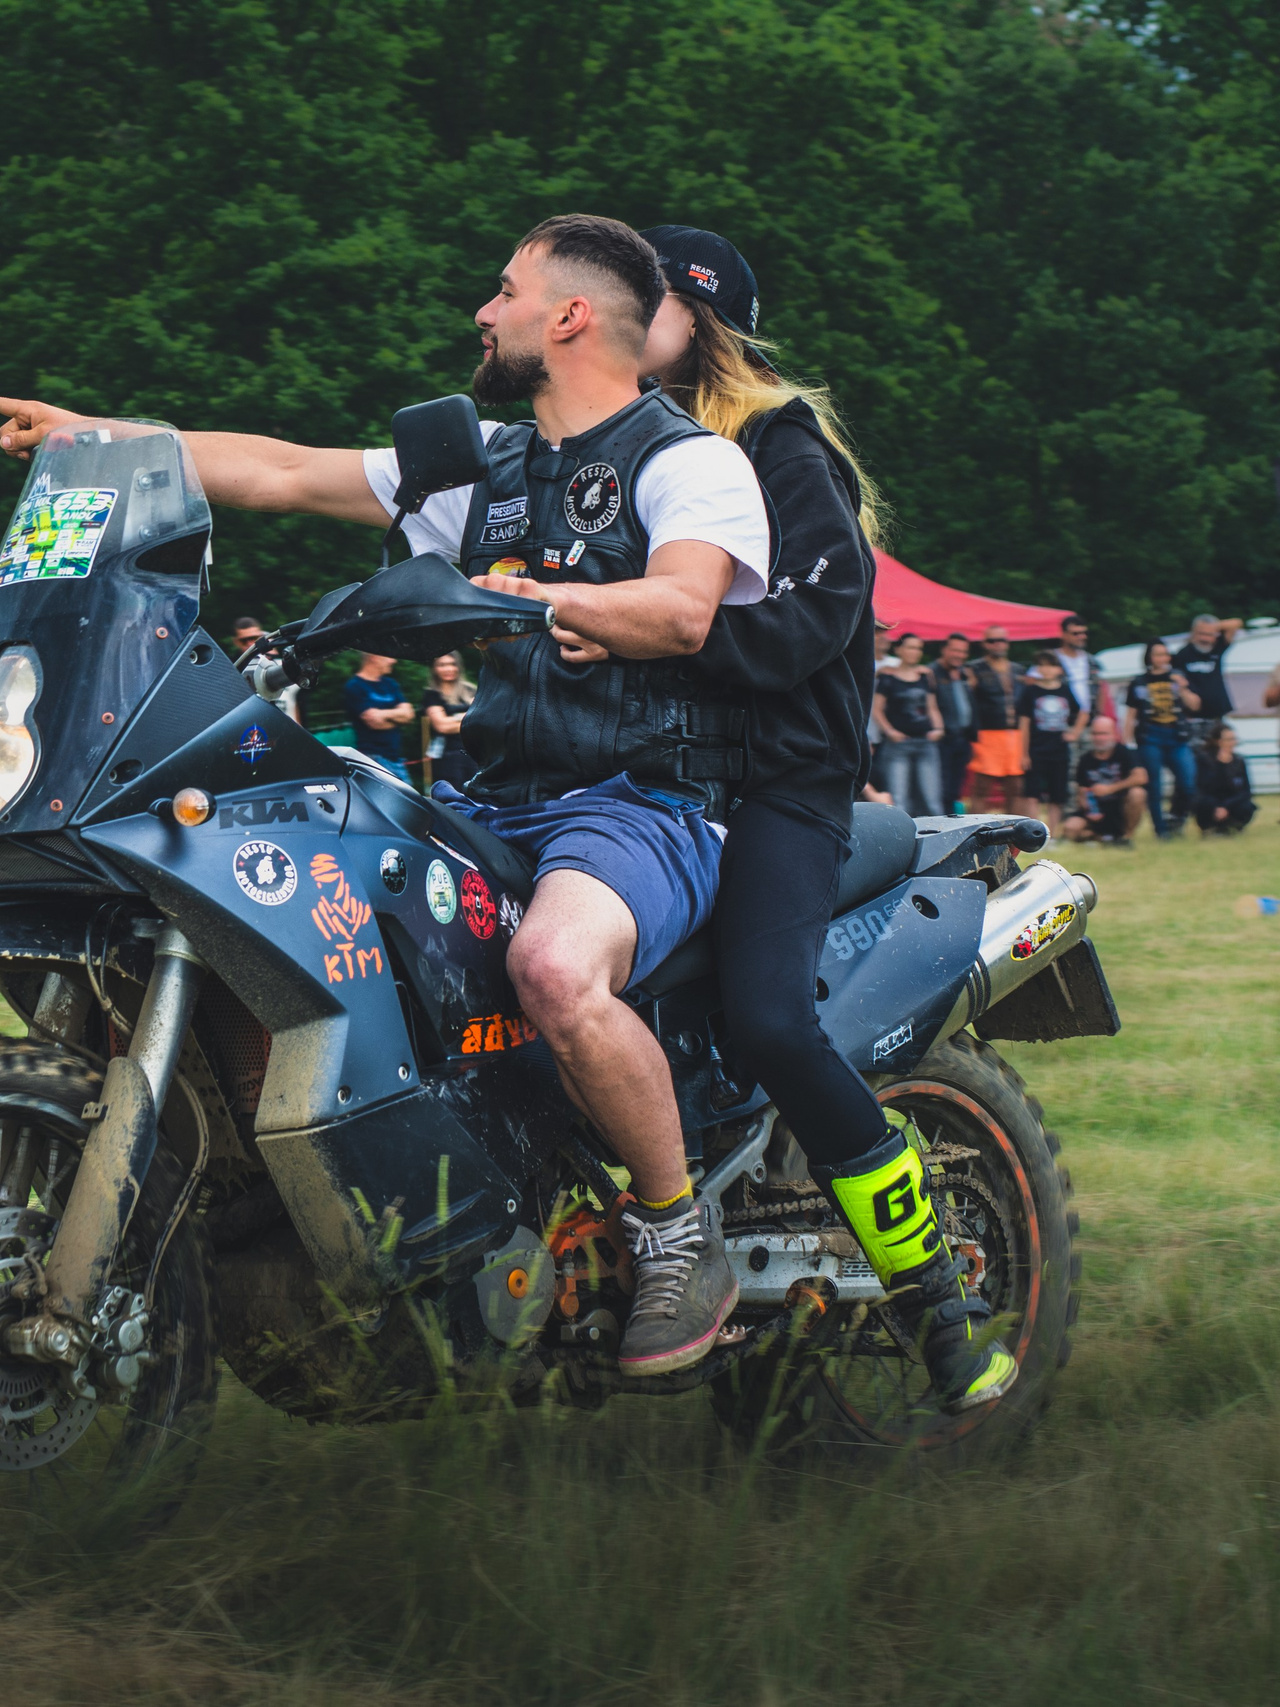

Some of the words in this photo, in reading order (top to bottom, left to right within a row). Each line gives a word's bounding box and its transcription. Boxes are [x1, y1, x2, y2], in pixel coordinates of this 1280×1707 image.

[690, 263, 717, 278] READY
[709, 276, 719, 287] TO
[696, 278, 718, 294] RACE
[53, 492, 114, 512] 653
[566, 495, 619, 531] MOTOCICLISTILOR
[51, 510, 97, 521] SANDU
[219, 797, 310, 830] KTM
[826, 910, 894, 961] 990
[323, 942, 383, 984] KTM
[873, 1023, 914, 1065] KTM
